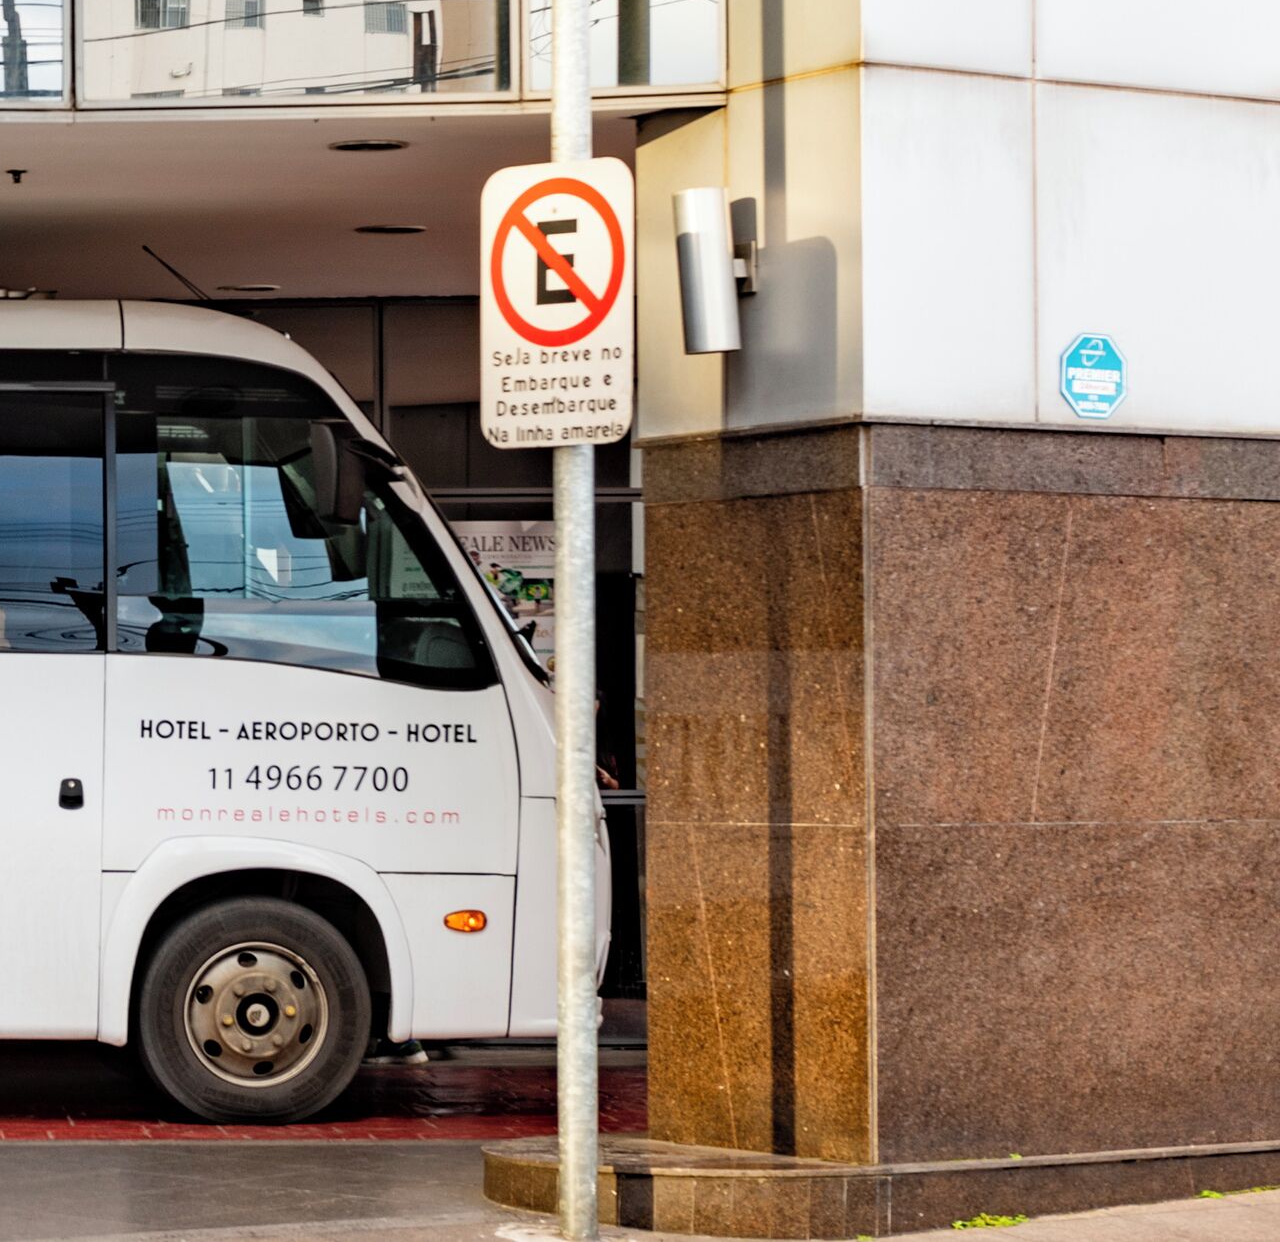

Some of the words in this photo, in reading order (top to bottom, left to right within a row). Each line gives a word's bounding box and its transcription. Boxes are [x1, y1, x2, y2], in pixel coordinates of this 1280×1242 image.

[536, 219, 577, 306] E
[540, 349, 591, 364] breve
[601, 346, 622, 360] no
[502, 374, 591, 393] Embarque
[603, 374, 613, 386] e
[496, 398, 617, 417] Desembarque
[488, 427, 509, 443] Na
[516, 425, 554, 442] linha
[561, 422, 624, 440] amarela
[140, 719, 211, 740] HOTEL
[237, 721, 380, 742] AEROPORTO
[407, 723, 478, 743] HOTEL
[208, 767, 234, 791] 11
[245, 765, 323, 791] 4966
[333, 765, 410, 792] 7700
[157, 806, 461, 825] monrealehotels.com
